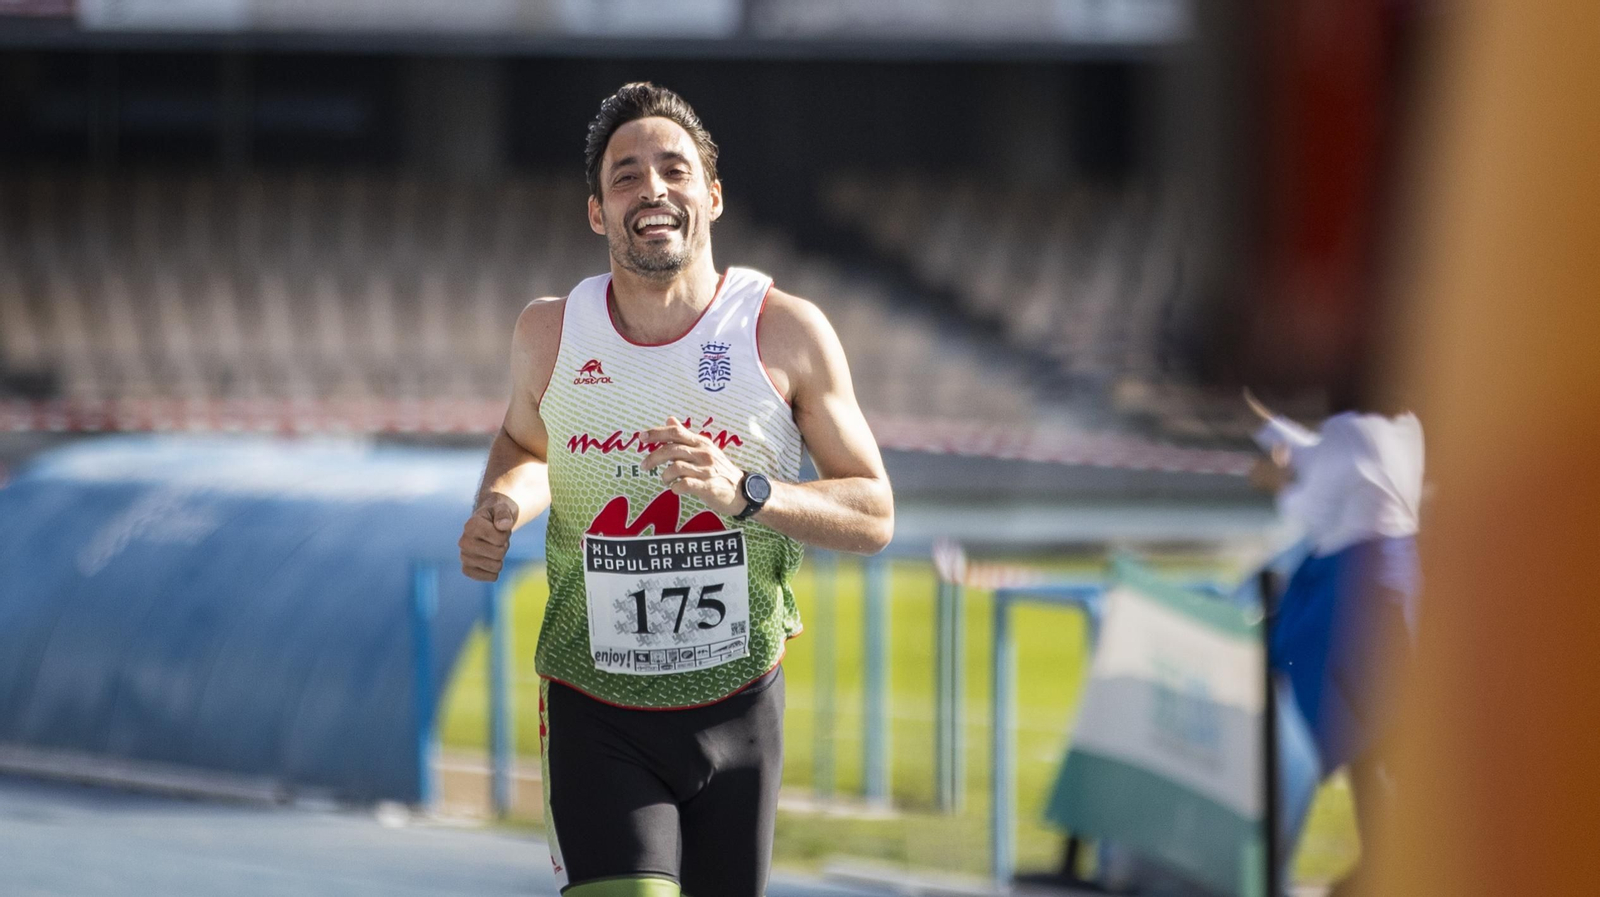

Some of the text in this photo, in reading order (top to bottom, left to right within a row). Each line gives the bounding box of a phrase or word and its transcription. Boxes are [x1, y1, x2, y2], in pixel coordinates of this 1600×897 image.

[567, 416, 744, 455] marn
[615, 464, 672, 478] JER
[648, 538, 738, 555] CARRERA
[593, 552, 739, 571] POPULAR JEREZ
[628, 583, 727, 634] 175
[595, 648, 631, 668] enjoy!
